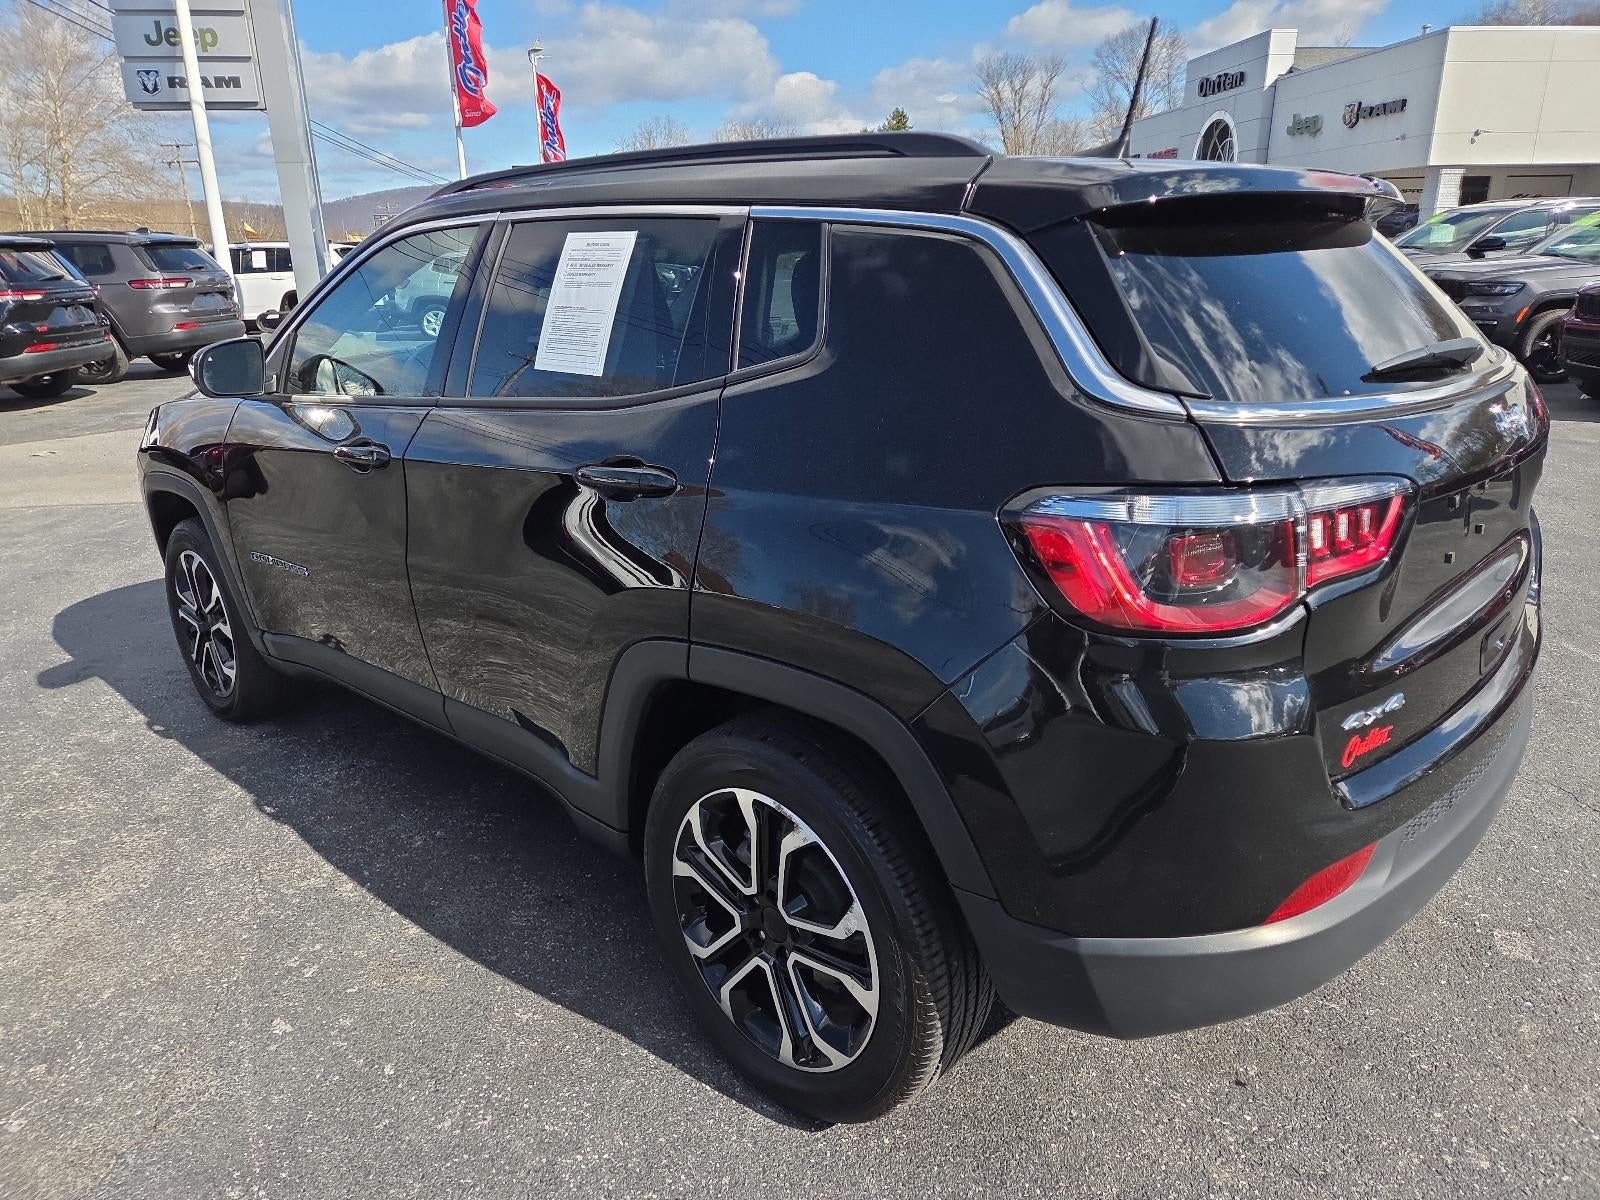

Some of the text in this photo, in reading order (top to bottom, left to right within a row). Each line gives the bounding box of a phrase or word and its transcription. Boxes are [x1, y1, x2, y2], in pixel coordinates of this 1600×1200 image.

[1198, 71, 1245, 97] Outten
[1359, 98, 1408, 119] RAM
[1286, 113, 1324, 138] Jeep
